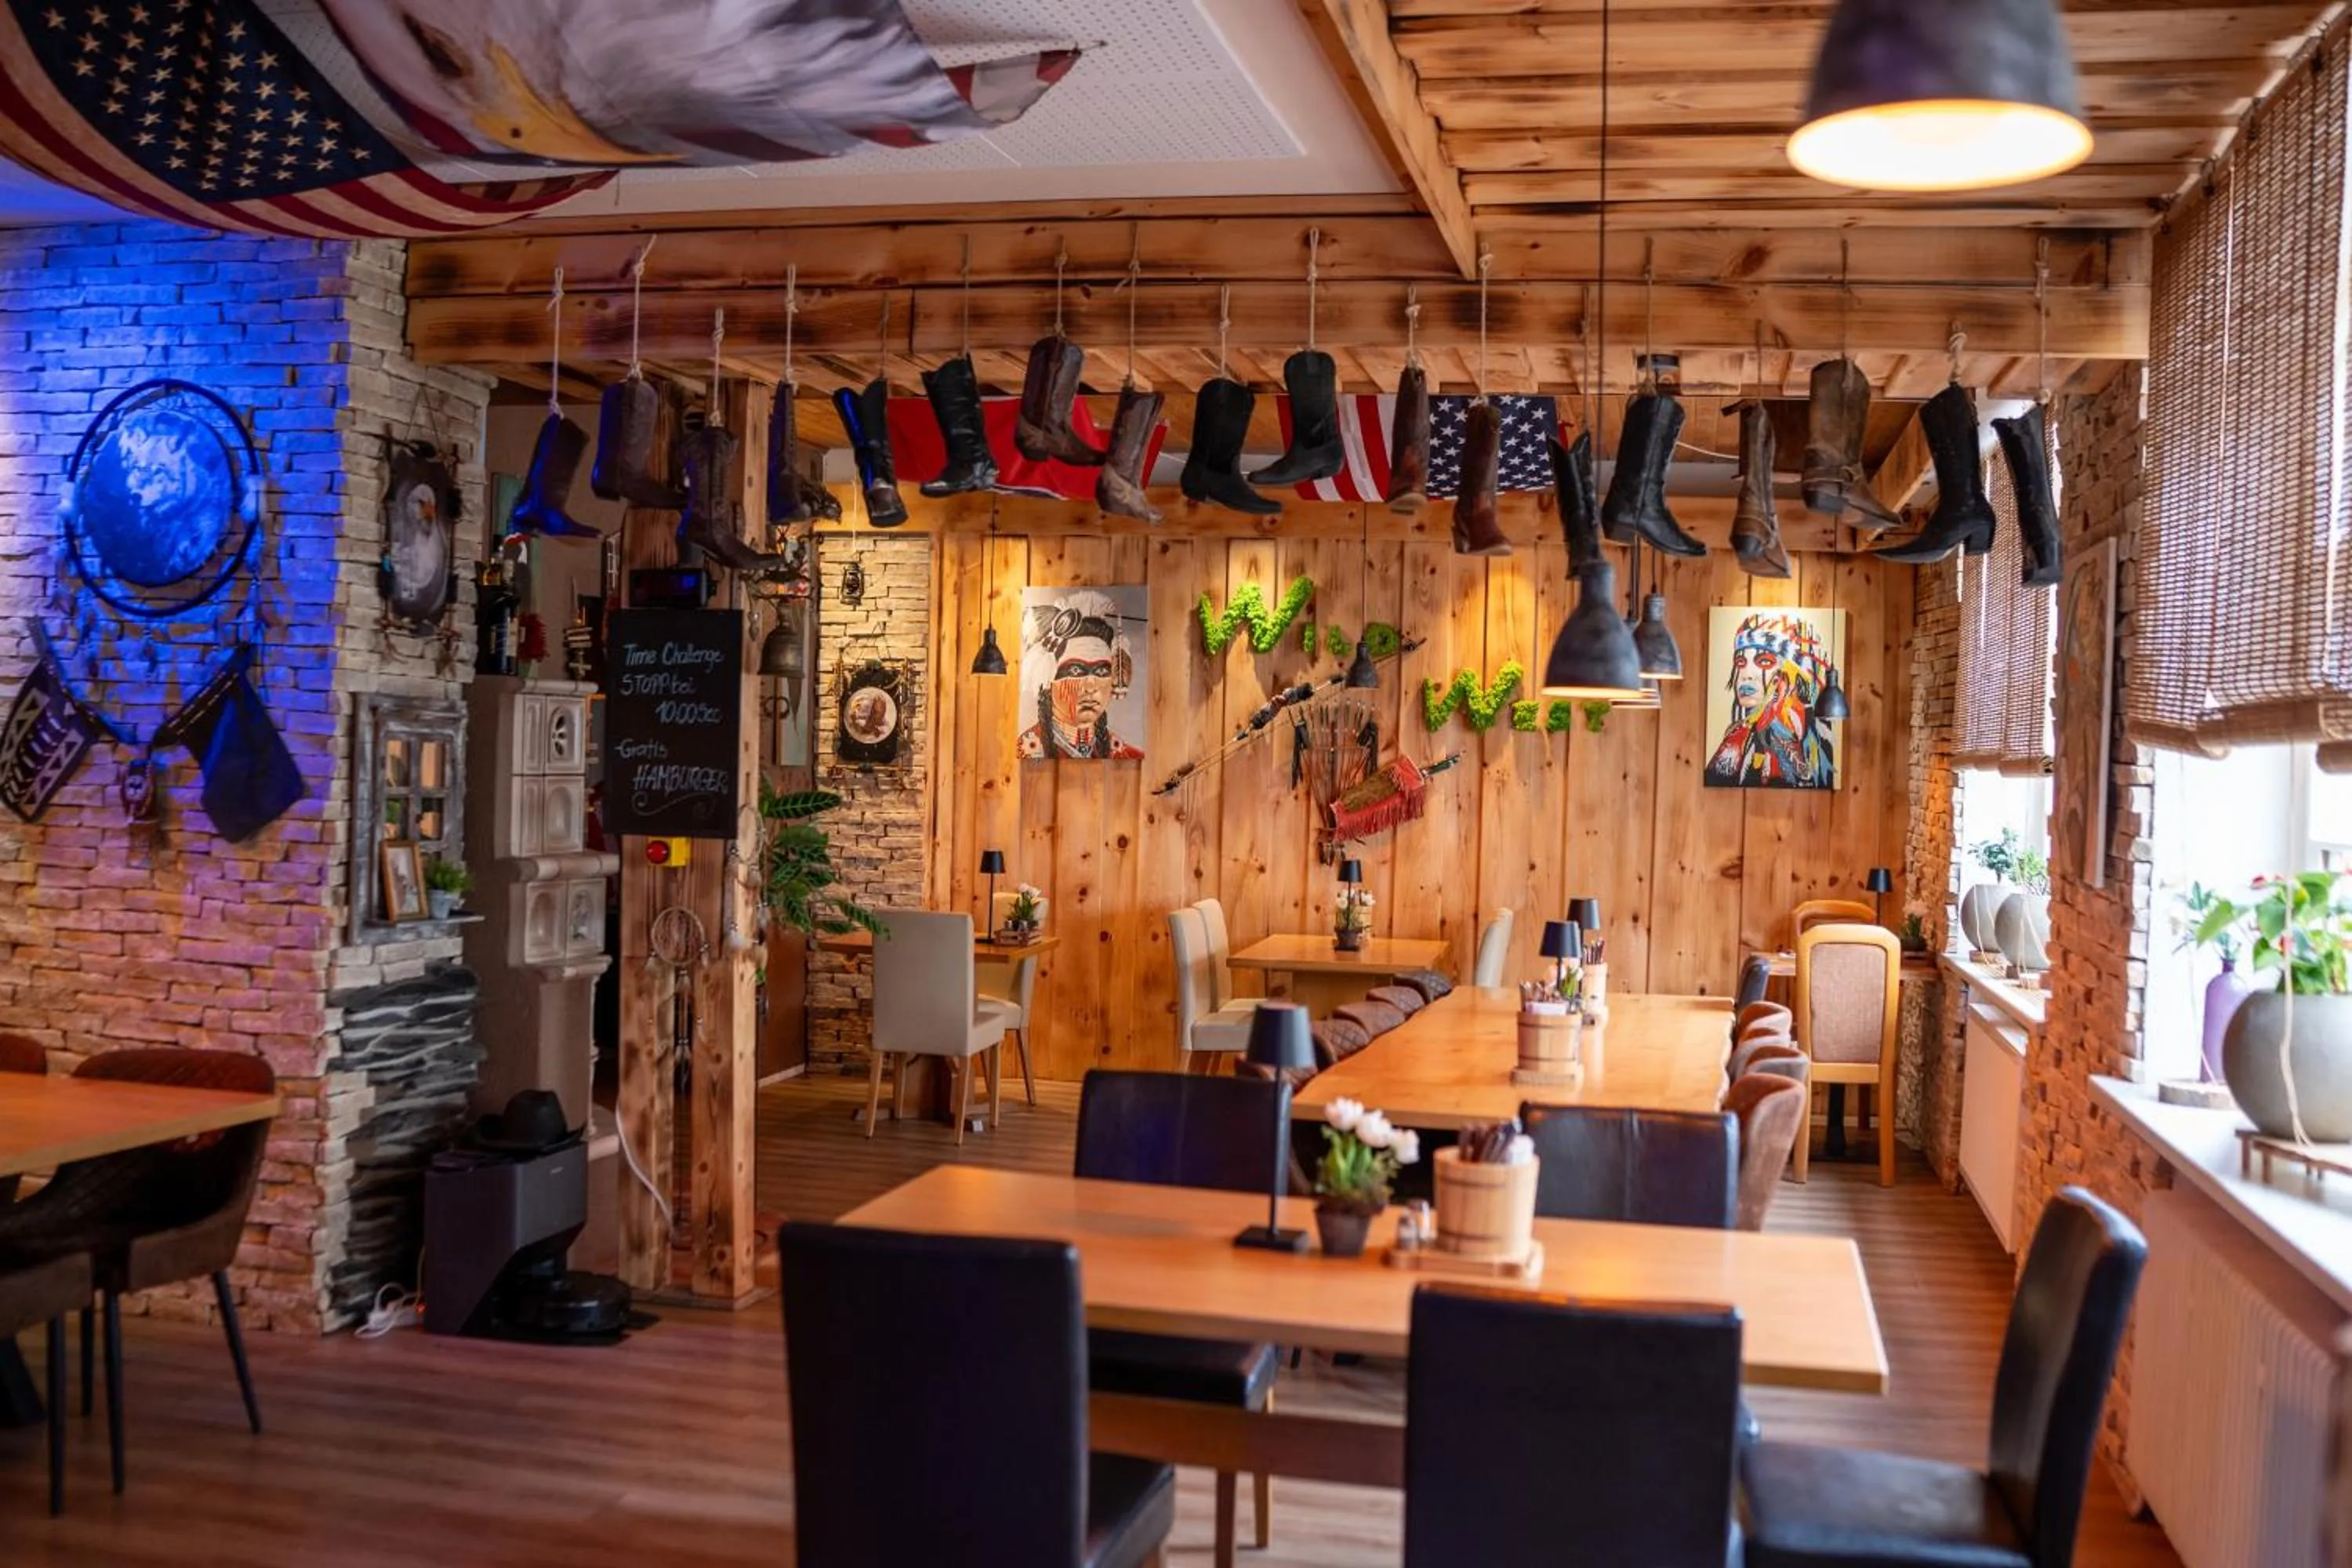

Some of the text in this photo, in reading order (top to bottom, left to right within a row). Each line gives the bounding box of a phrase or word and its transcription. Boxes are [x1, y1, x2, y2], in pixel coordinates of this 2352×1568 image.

[624, 641, 724, 673] Time Challenge
[620, 673, 696, 695] STOPP bei
[633, 764, 728, 797] HAMBURGER
